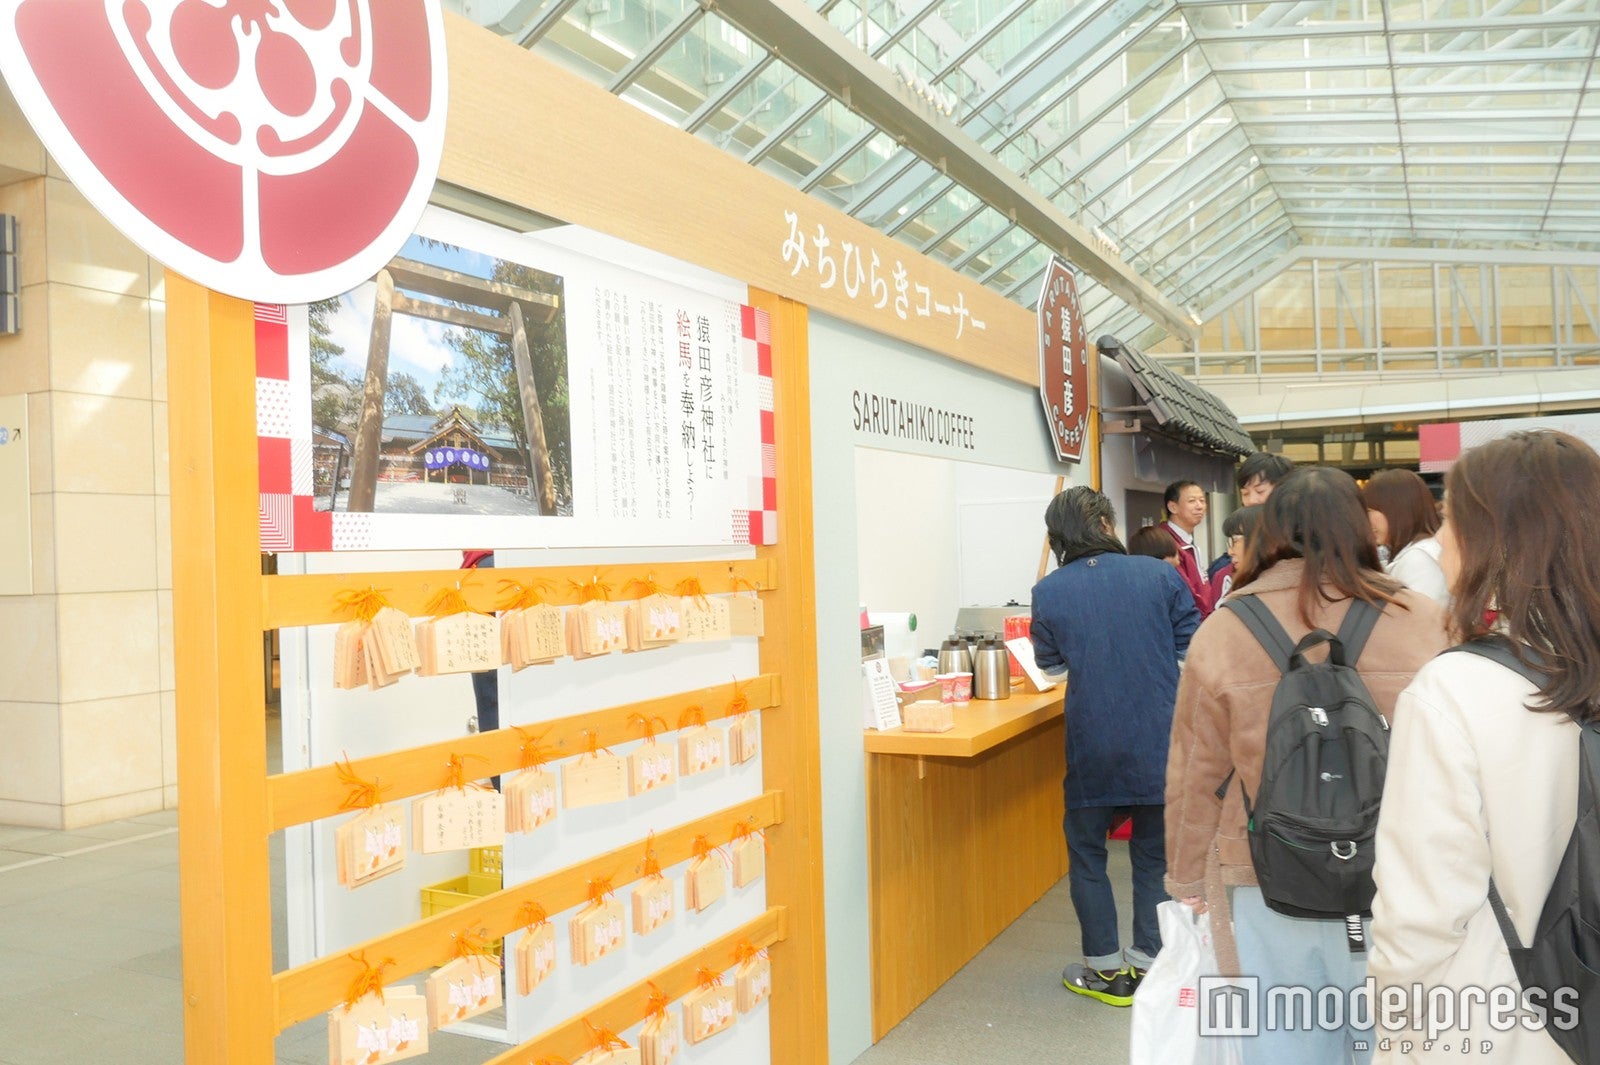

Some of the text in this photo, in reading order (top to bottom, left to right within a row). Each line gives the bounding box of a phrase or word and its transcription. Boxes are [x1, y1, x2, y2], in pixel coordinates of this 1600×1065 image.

[782, 209, 986, 340] みちひらきコーナー
[696, 315, 716, 479] 猿田彦神社に
[853, 389, 975, 450] SARUTAHIKO COFFEE
[1051, 404, 1085, 448] COFFEE
